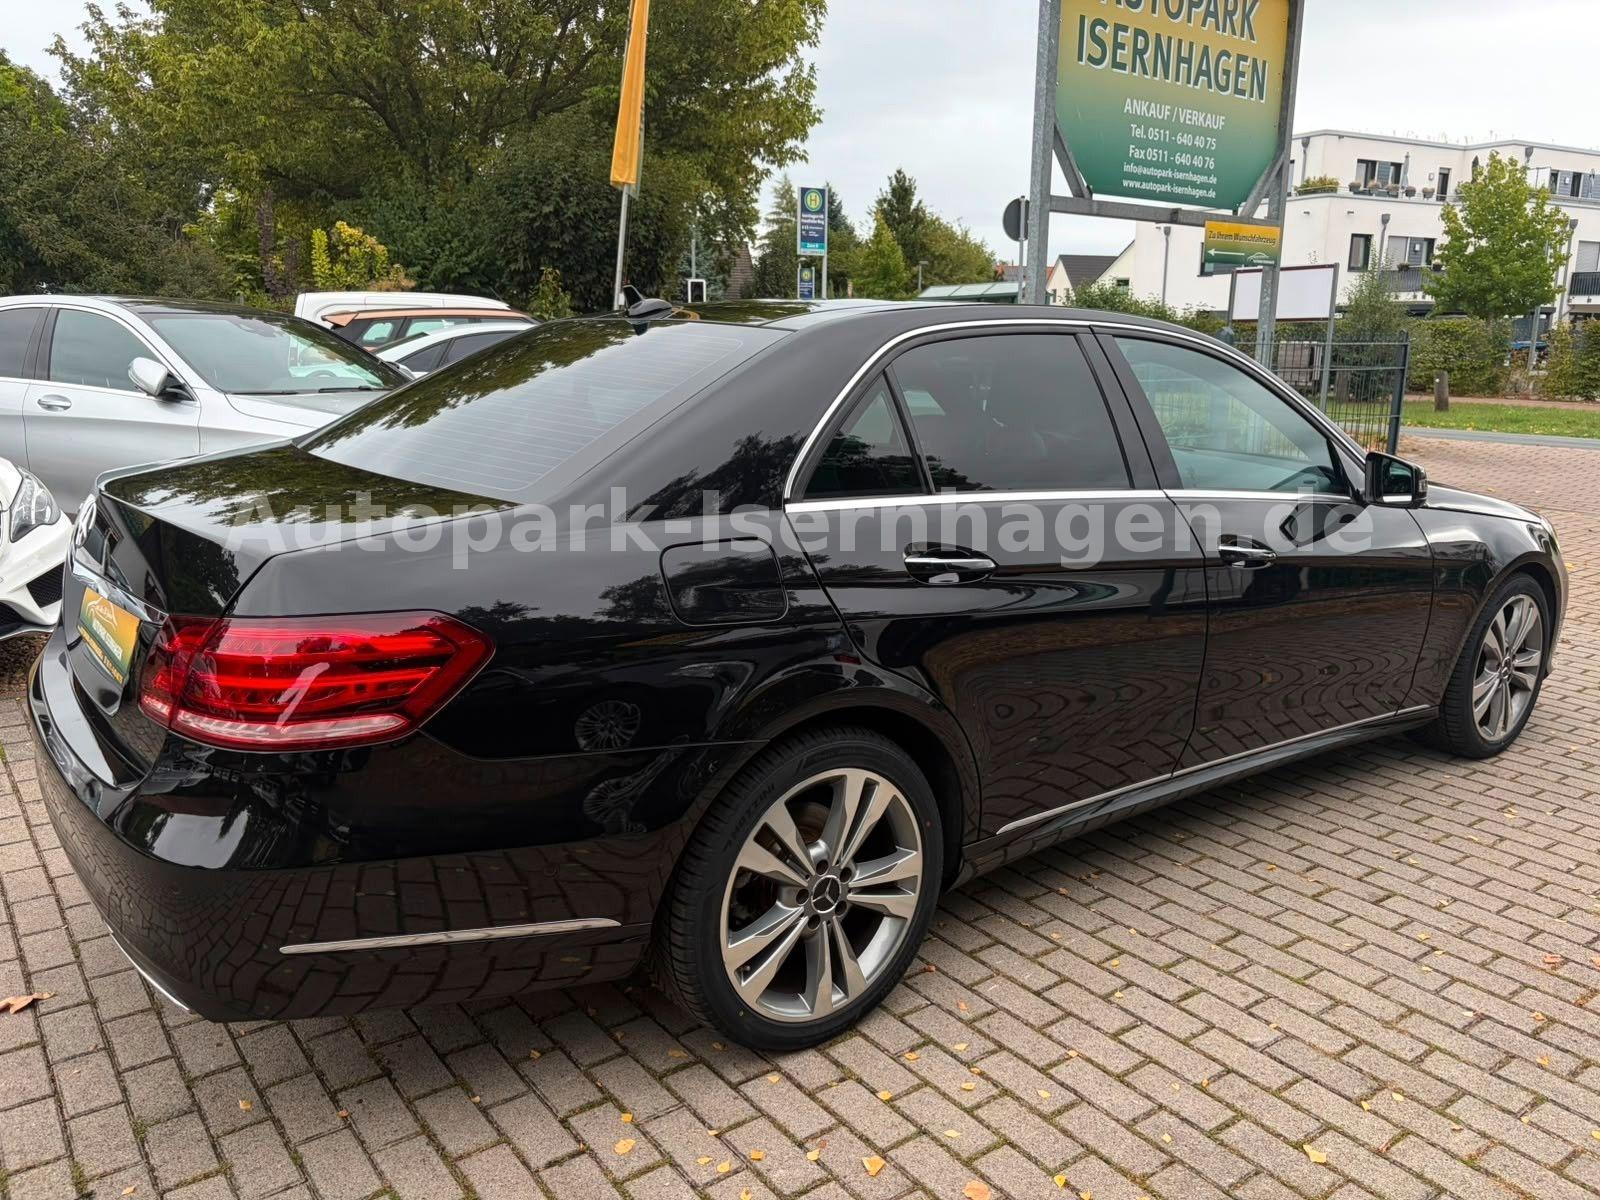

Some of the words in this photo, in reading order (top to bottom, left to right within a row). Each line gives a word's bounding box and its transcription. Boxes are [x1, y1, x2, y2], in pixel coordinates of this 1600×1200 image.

[1098, 0, 1259, 43] OPARK
[1077, 14, 1268, 104] ISERNHAGEN
[1124, 97, 1171, 121] ANKAUF
[1179, 107, 1226, 130] VERKAUF
[1131, 124, 1146, 139] Tel.
[1147, 127, 1169, 143] 0511
[1176, 132, 1193, 147] 640
[1194, 135, 1205, 149] 40
[1206, 137, 1217, 150] 75
[1129, 144, 1146, 160] Fax
[1146, 147, 1168, 163] 0511
[1175, 152, 1192, 167] 640
[1192, 155, 1204, 169] 40
[1204, 156, 1215, 170] 76
[1123, 161, 1218, 185] info@autopark-isernhagen.de
[1122, 178, 1217, 199] www.autopark-isernhagen.de
[1216, 231, 1233, 242] Ihrem
[1233, 232, 1277, 246] Wunschfahrzeug
